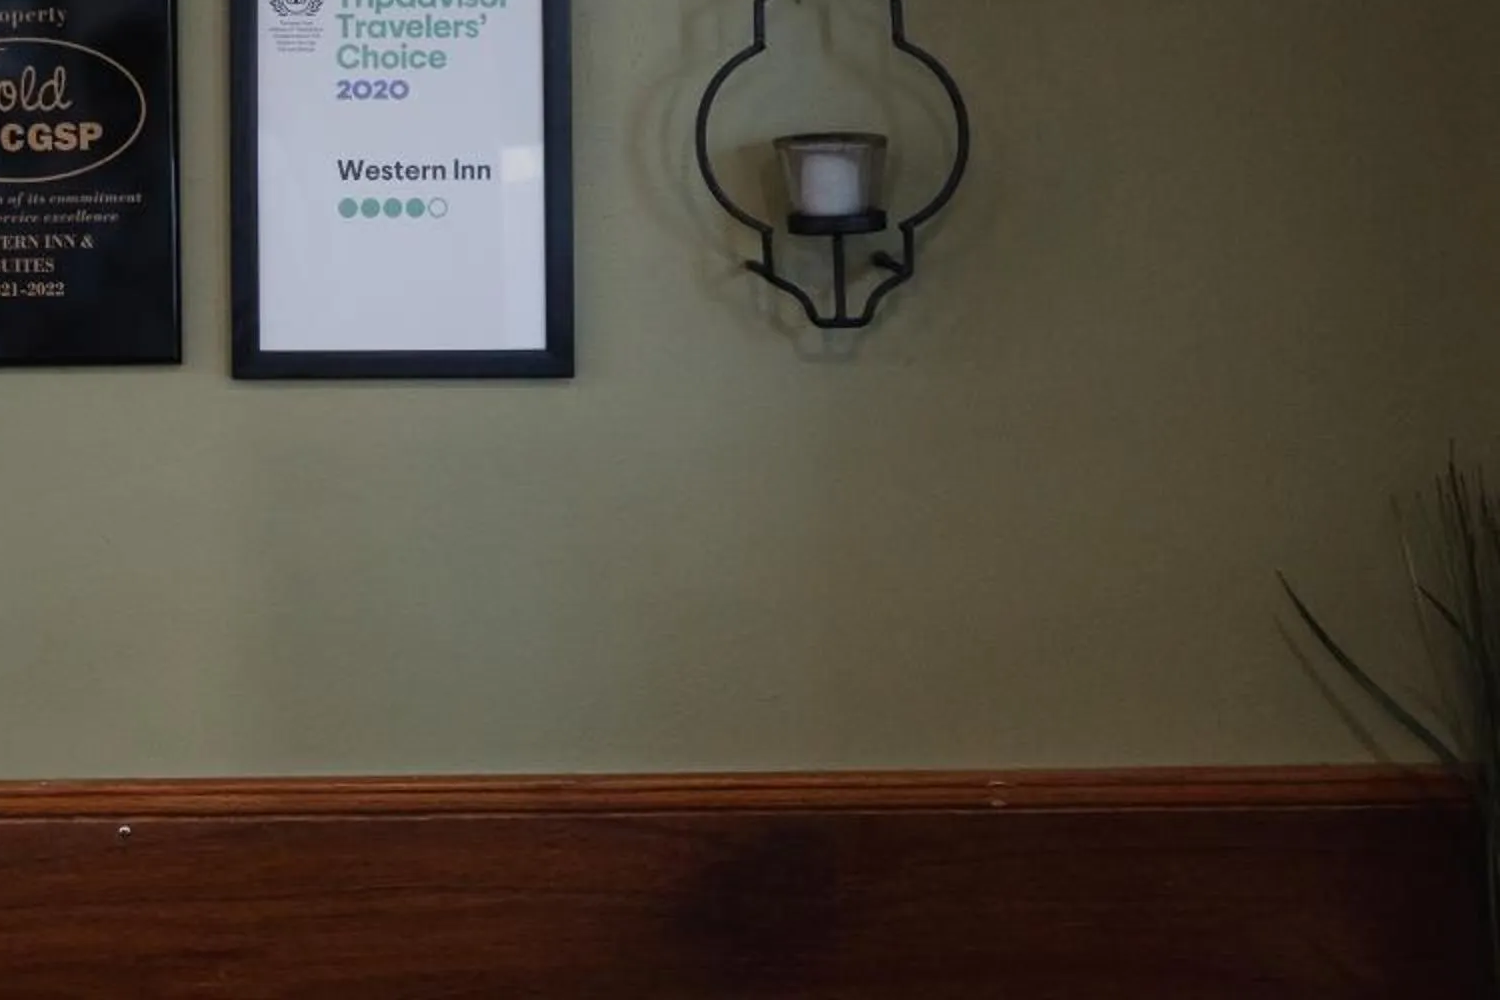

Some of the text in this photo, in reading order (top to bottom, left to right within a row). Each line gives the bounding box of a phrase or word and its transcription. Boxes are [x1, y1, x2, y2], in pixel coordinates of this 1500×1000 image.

[336, 43, 448, 69] Choice
[336, 79, 410, 101] 2020
[0, 122, 103, 151] CGSP
[337, 158, 492, 181] Western Inn
[7, 192, 25, 207] of
[27, 193, 46, 206] its
[49, 191, 143, 205] commitment
[43, 208, 120, 224] excellence
[44, 234, 76, 249] INN
[80, 234, 95, 249] &
